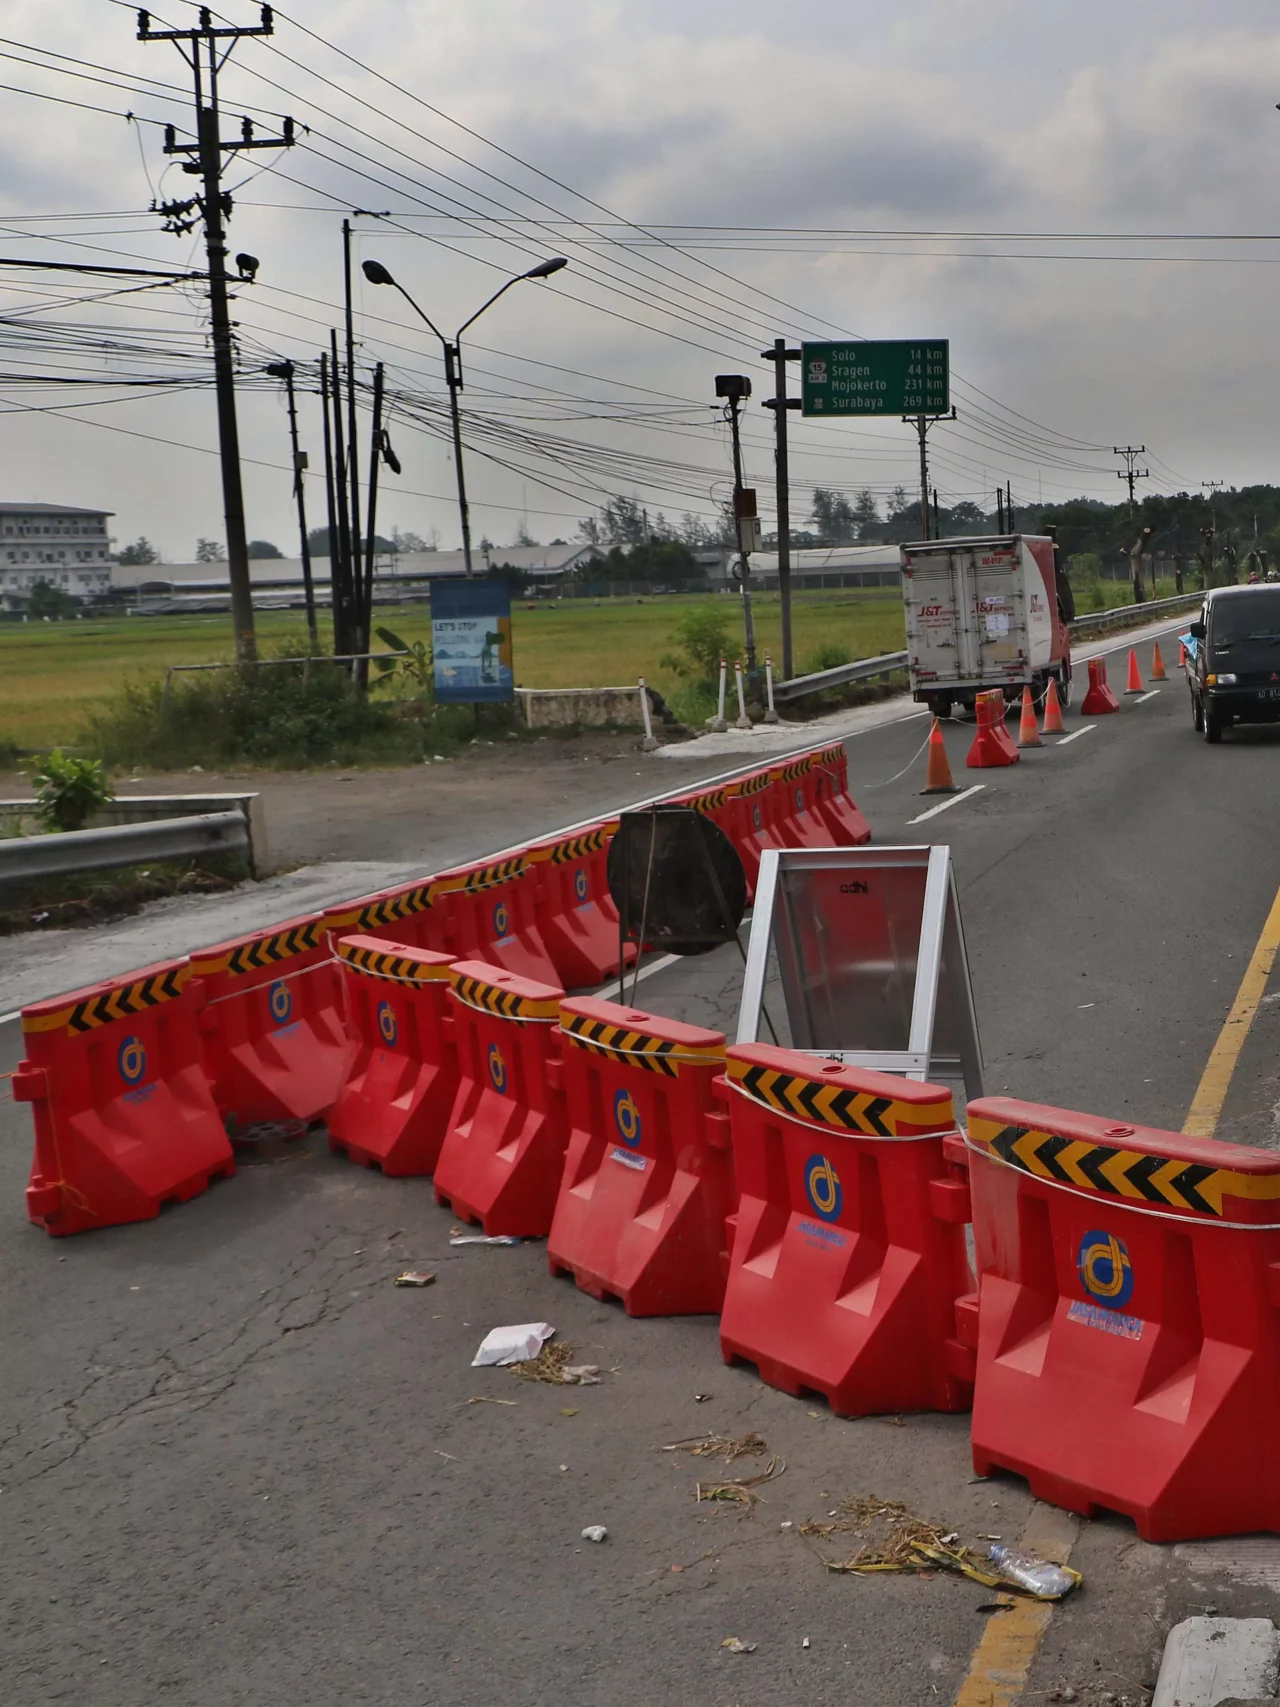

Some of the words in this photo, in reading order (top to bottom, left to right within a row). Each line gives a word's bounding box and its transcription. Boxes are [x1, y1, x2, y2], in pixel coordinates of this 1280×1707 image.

[832, 350, 856, 362] Solo
[910, 350, 922, 360] 14
[926, 349, 943, 360] km
[812, 363, 823, 372] 15
[832, 365, 870, 378] Sragen
[908, 365, 922, 375] 44
[926, 364, 943, 375] km
[832, 380, 887, 393] Mojokerto
[904, 379, 922, 390] 231
[926, 378, 943, 389] km
[832, 396, 884, 409] Surabaya
[903, 396, 922, 407] 269
[926, 395, 943, 407] km
[917, 605, 943, 617] J&T
[840, 881, 868, 894] adhi
